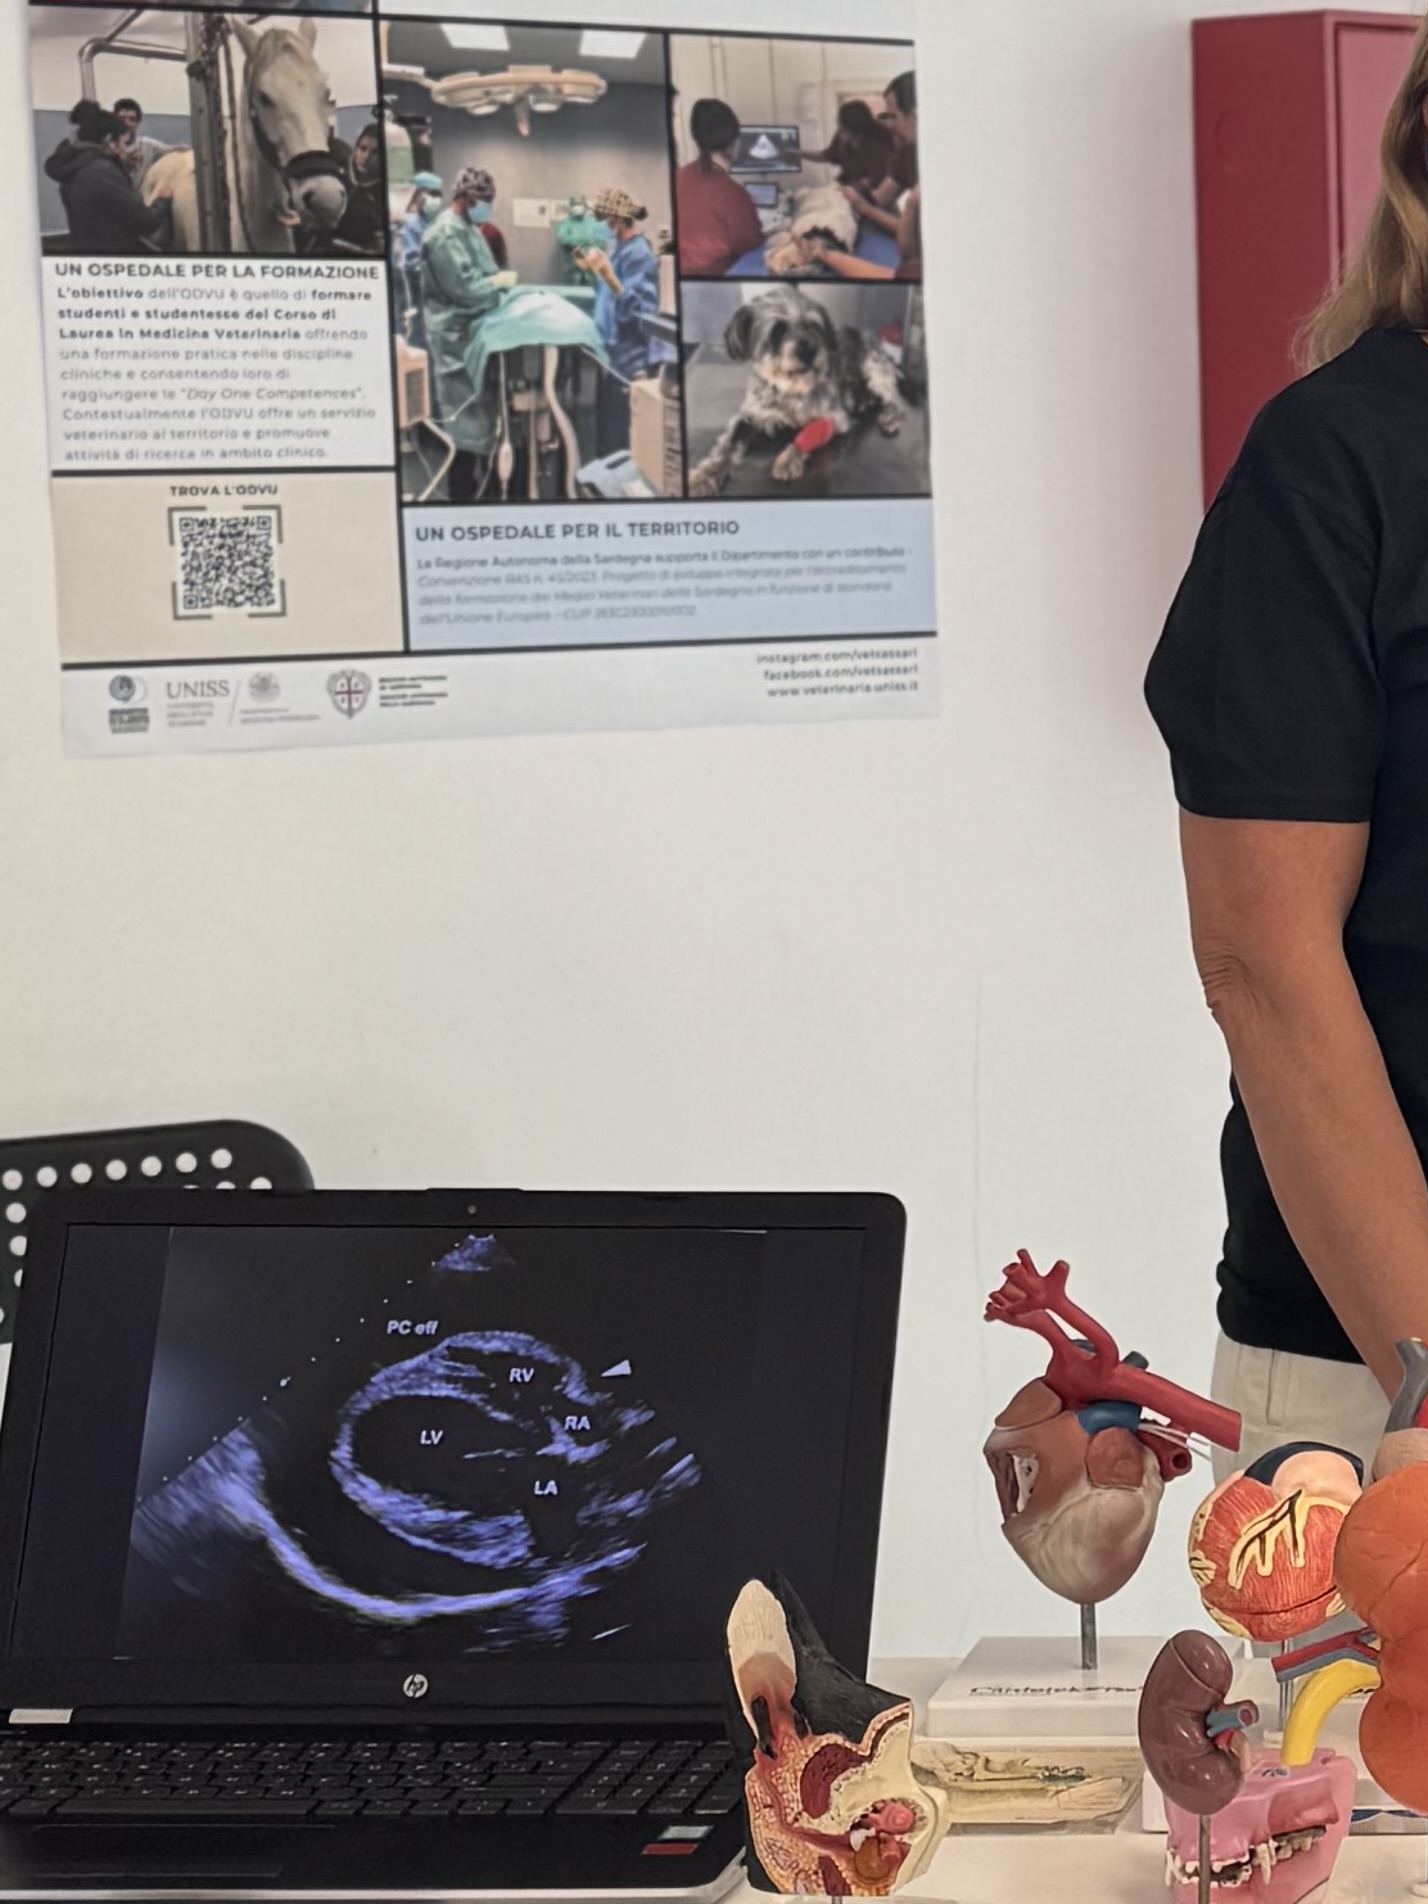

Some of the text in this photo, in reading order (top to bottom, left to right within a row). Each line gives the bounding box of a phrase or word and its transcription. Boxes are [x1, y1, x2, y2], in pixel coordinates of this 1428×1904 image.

[55, 262, 379, 280] UN OSPEDALE PER LA FORMAZIONE
[57, 286, 144, 299] L'obiettivo
[148, 286, 225, 300] dell'ODVU
[243, 287, 289, 304] quello
[293, 288, 307, 301] di
[311, 288, 372, 301] formare
[58, 307, 126, 320] studenti
[145, 308, 240, 321] studentesse
[245, 308, 269, 321] del
[274, 308, 317, 321] Corso
[321, 308, 336, 321] di
[59, 328, 368, 341] Laurea in Medicina Veterinaria offrendo
[169, 483, 278, 497] TROVA L'ODVU
[415, 520, 740, 542] UN OSPEDALE PER IL TERRITORIO
[757, 648, 918, 665] instagram.com/vetsassari
[764, 664, 918, 681] facebook.com/vetsassari
[166, 679, 231, 699] UNISS
[387, 1320, 439, 1335] PC eff
[509, 1368, 535, 1383] RV
[564, 1415, 591, 1431] RA
[420, 1430, 443, 1445] LV
[534, 1480, 558, 1496] LA
